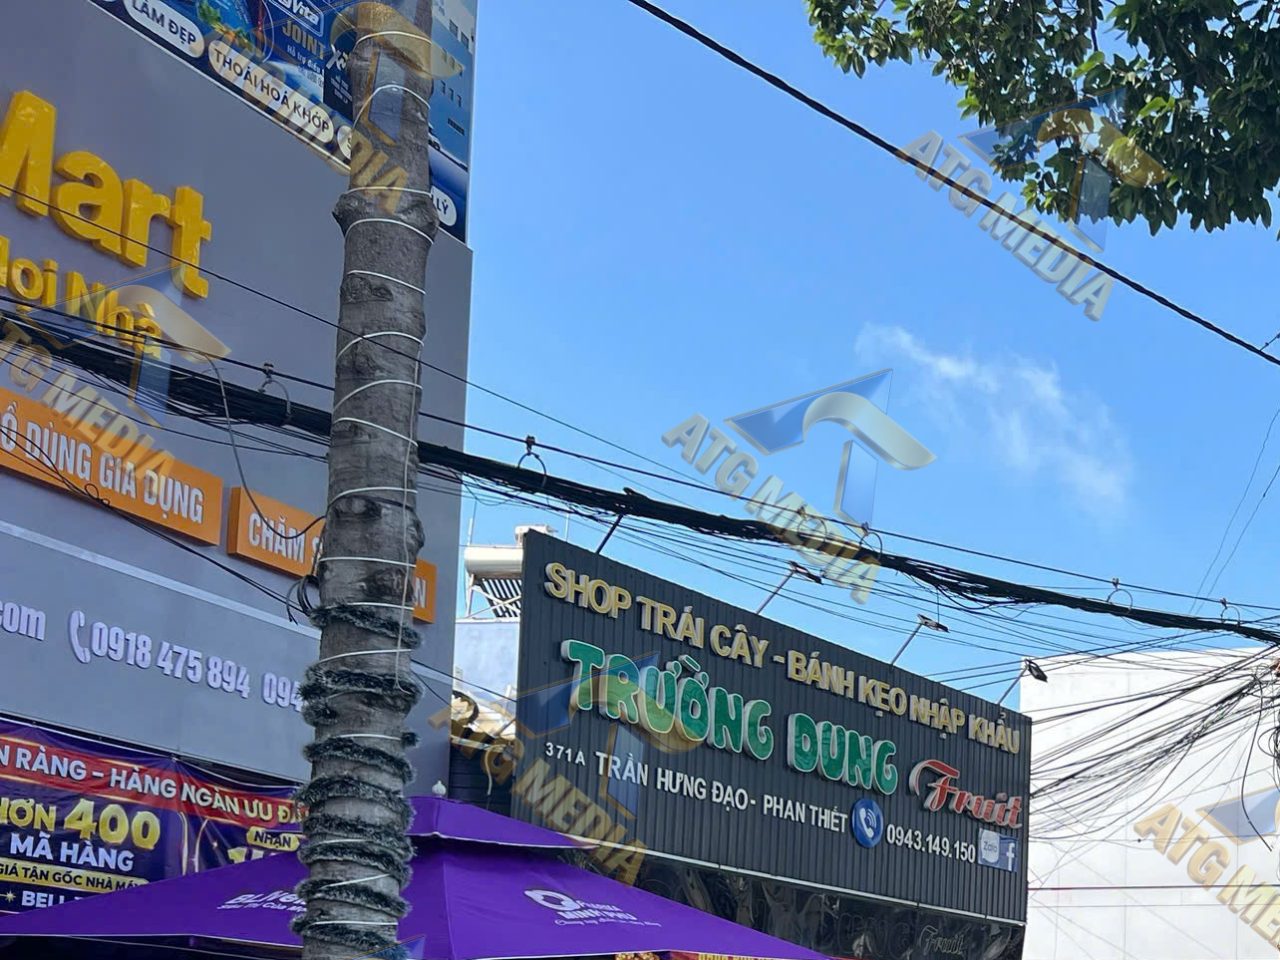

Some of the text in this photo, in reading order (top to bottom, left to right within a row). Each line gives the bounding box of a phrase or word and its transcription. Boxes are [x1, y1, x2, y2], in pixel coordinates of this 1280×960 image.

[167, 18, 197, 45] ĐẸP
[282, 20, 326, 60] JOINT
[292, 101, 331, 134] KHỚP
[26, 421, 204, 524] DÙNG GIA DỤNG
[91, 621, 152, 670] 0918
[156, 641, 202, 684] 475
[207, 656, 250, 700] 894
[545, 561, 1021, 756] SHOP TRÁI CÂY BÁNH KẸO NHẬP KHẨU
[561, 638, 899, 797] TRƯỜNG DUNG
[15, 745, 87, 781] RÀNG
[110, 766, 176, 799] HÀNG
[181, 782, 240, 816] NGÀN
[243, 797, 273, 821] ƯU
[545, 742, 586, 767] 371A
[595, 750, 649, 788] TRẦN
[656, 767, 707, 801] HƯNG
[763, 792, 806, 824] PHAN
[809, 800, 849, 834] THIẾT
[909, 758, 1023, 829] Fruit
[10, 832, 135, 872] MÃ HÀNG
[64, 797, 160, 850] 400
[886, 823, 977, 864] 0943.149.150
[52, 871, 83, 886] GỐC
[86, 876, 113, 890] NHÀ
